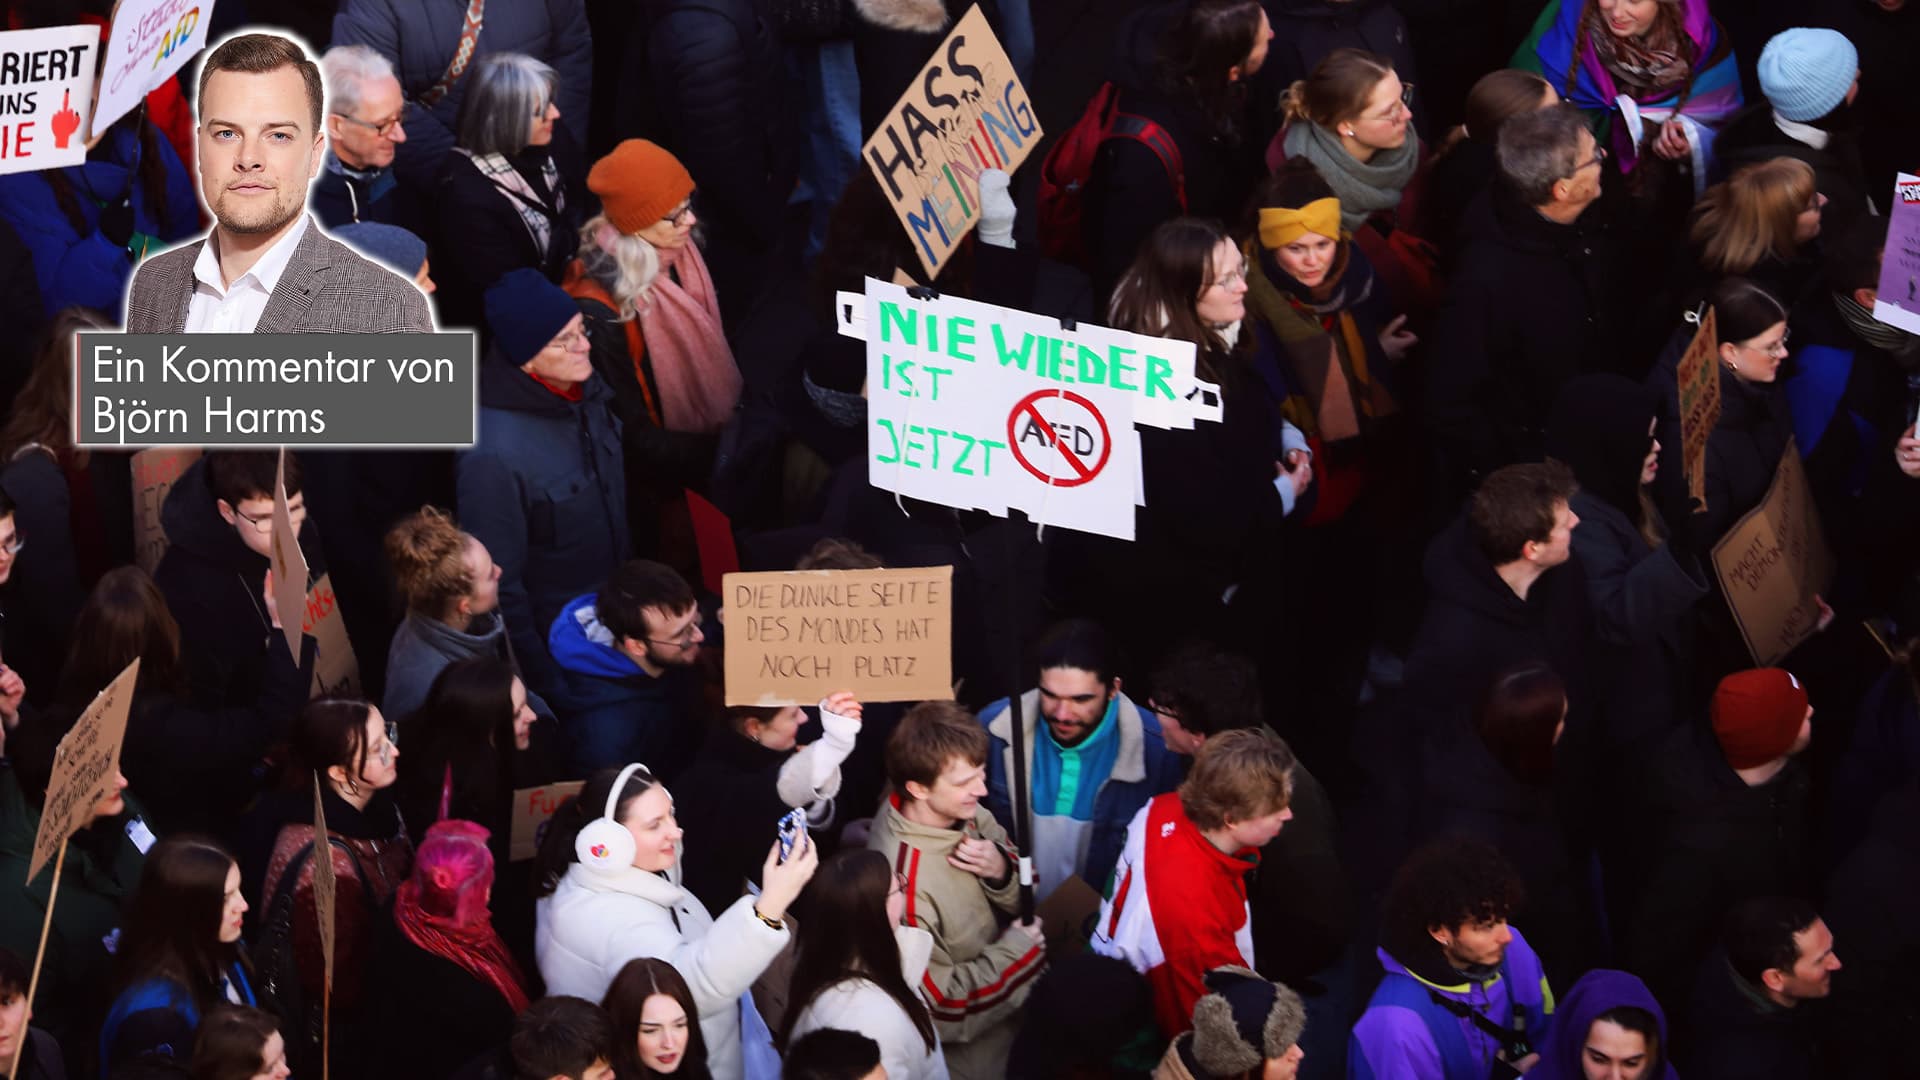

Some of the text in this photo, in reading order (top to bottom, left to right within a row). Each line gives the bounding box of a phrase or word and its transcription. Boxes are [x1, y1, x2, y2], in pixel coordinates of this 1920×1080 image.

[152, 6, 200, 70] AfD
[870, 35, 984, 201] HASS
[906, 79, 1036, 267] MEINUNG
[879, 301, 1178, 401] NIE WIEDER
[882, 354, 953, 400] IST
[876, 418, 1006, 476] JETZT
[736, 580, 944, 608] DIE DUNKLE SEITE
[746, 615, 936, 645] DES MONDES HAT
[760, 653, 917, 679] NOCH PLATZ
